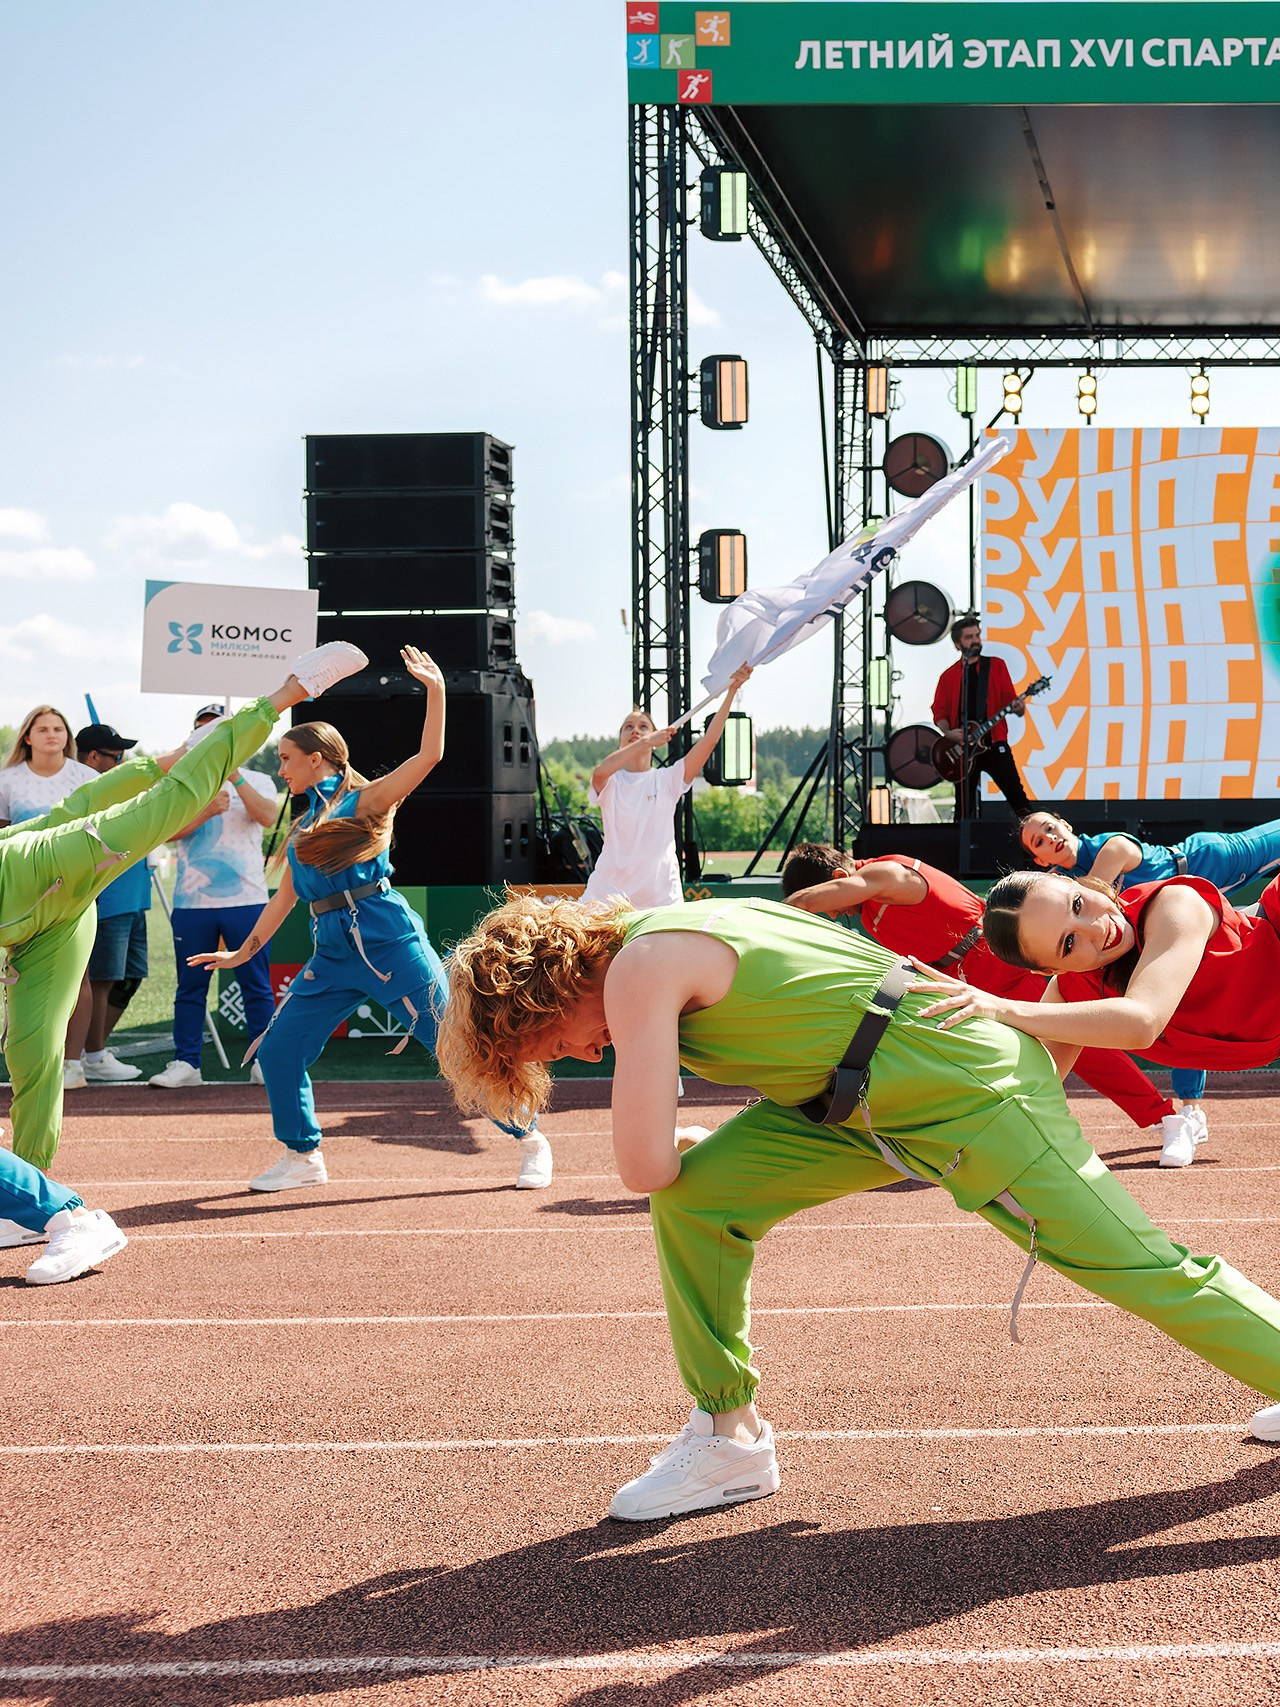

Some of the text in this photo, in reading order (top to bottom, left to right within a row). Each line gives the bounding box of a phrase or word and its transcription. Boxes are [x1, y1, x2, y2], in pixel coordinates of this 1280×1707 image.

[795, 33, 952, 69] ЛЕТНИЙ
[963, 39, 1060, 68] ЭТАП
[1070, 39, 1133, 67] XVI
[211, 624, 292, 643] КОМОС
[211, 643, 260, 652] МИЛКОМ
